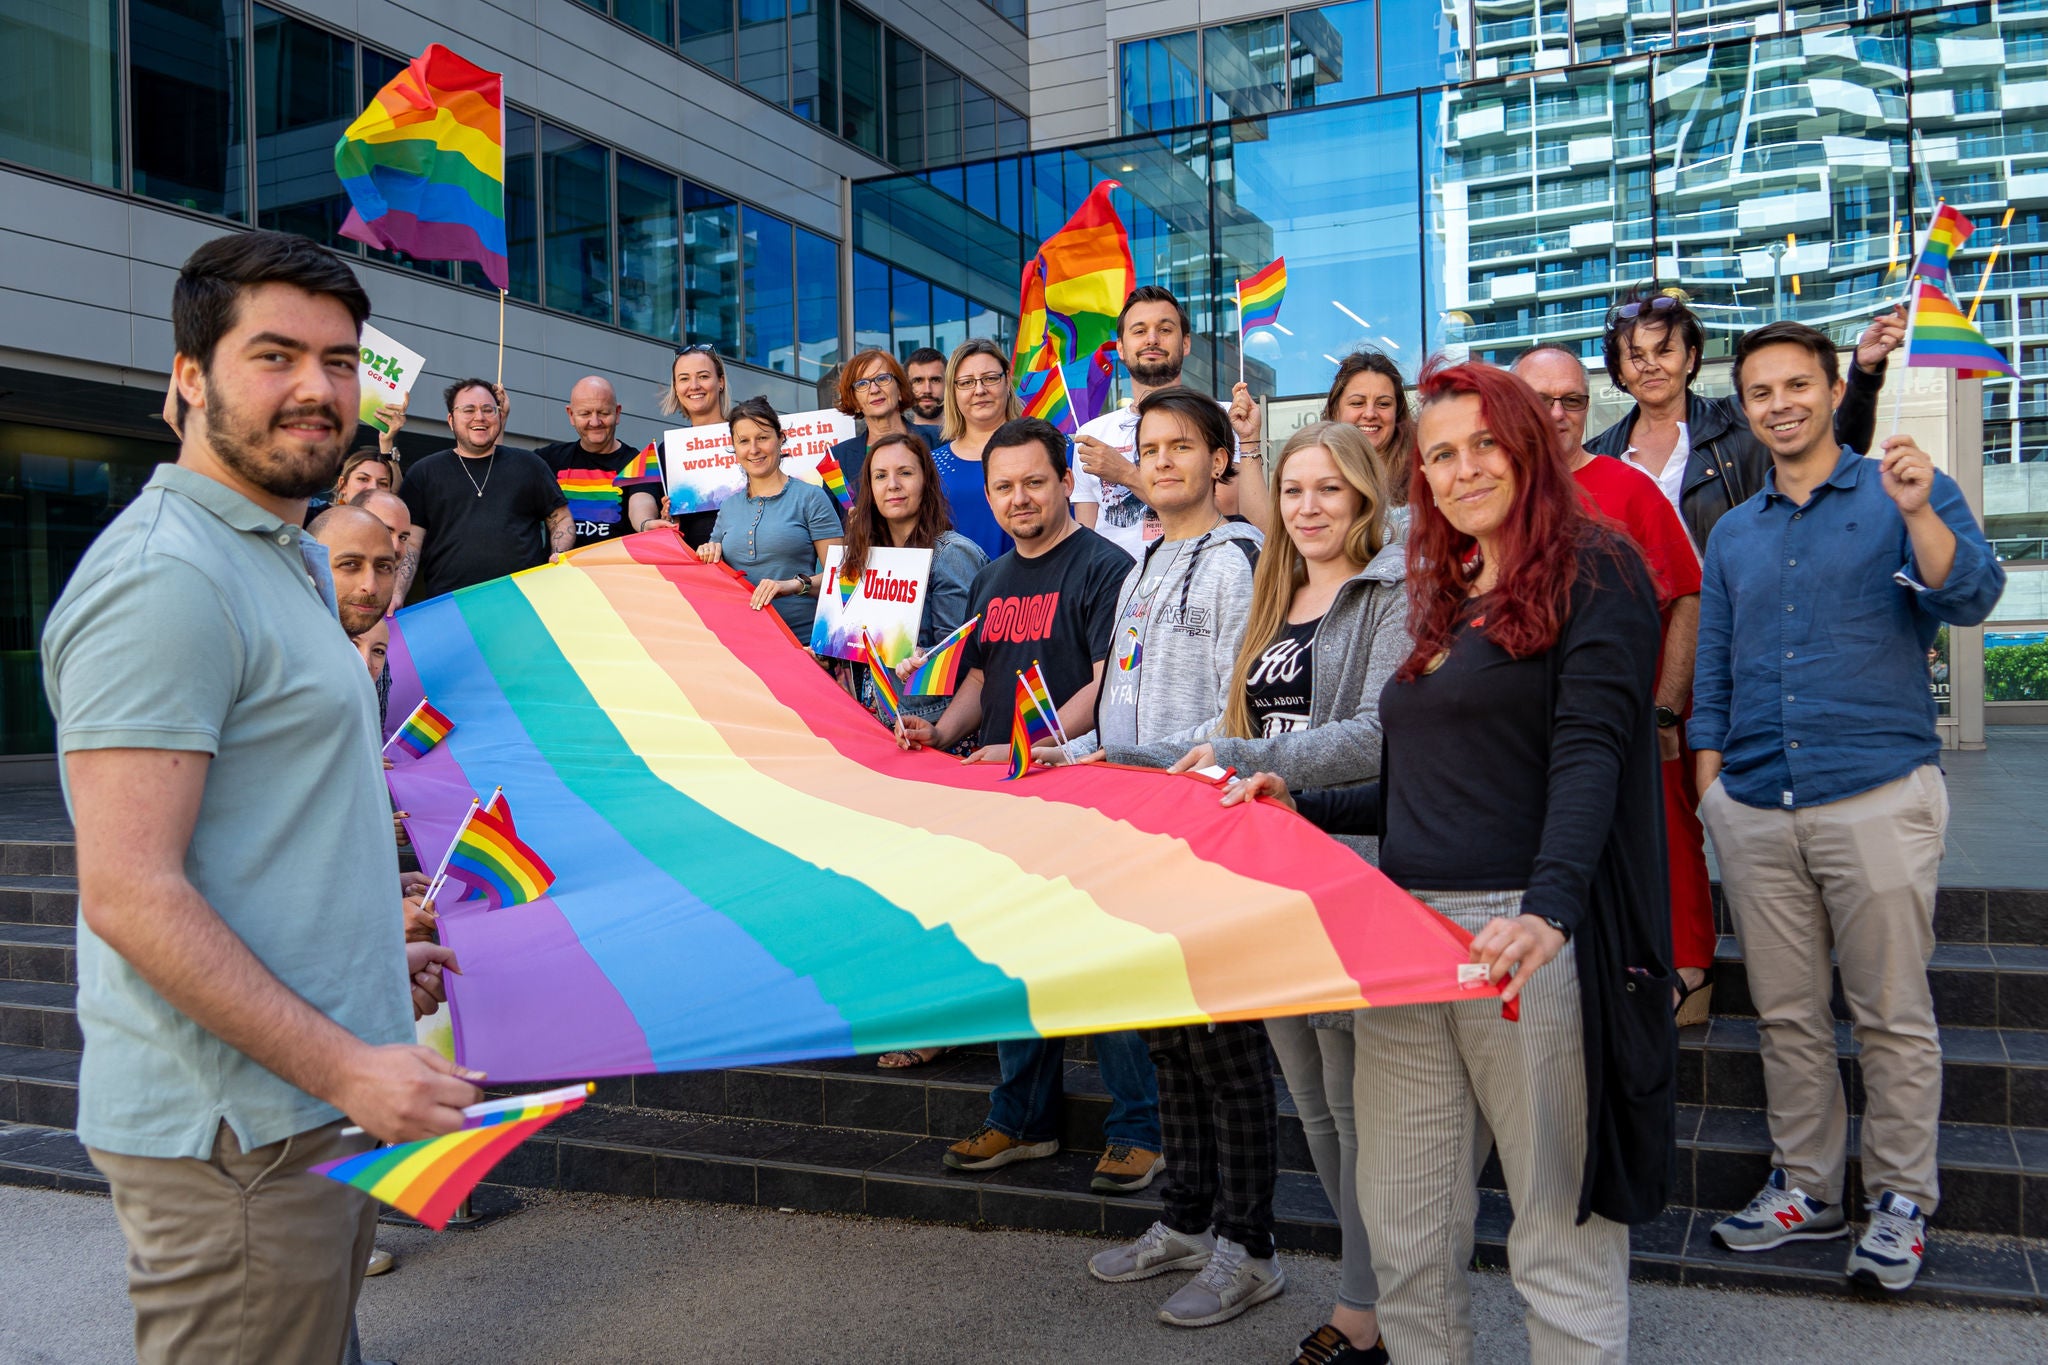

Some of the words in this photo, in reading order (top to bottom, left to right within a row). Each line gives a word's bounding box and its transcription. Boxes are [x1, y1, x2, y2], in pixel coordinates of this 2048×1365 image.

[359, 345, 404, 382] ork
[817, 421, 833, 434] in
[575, 520, 610, 536] IDE
[826, 567, 837, 594] I
[863, 569, 918, 604] Unions
[1254, 698, 1271, 708] ALL
[1273, 696, 1305, 706] ABOUT
